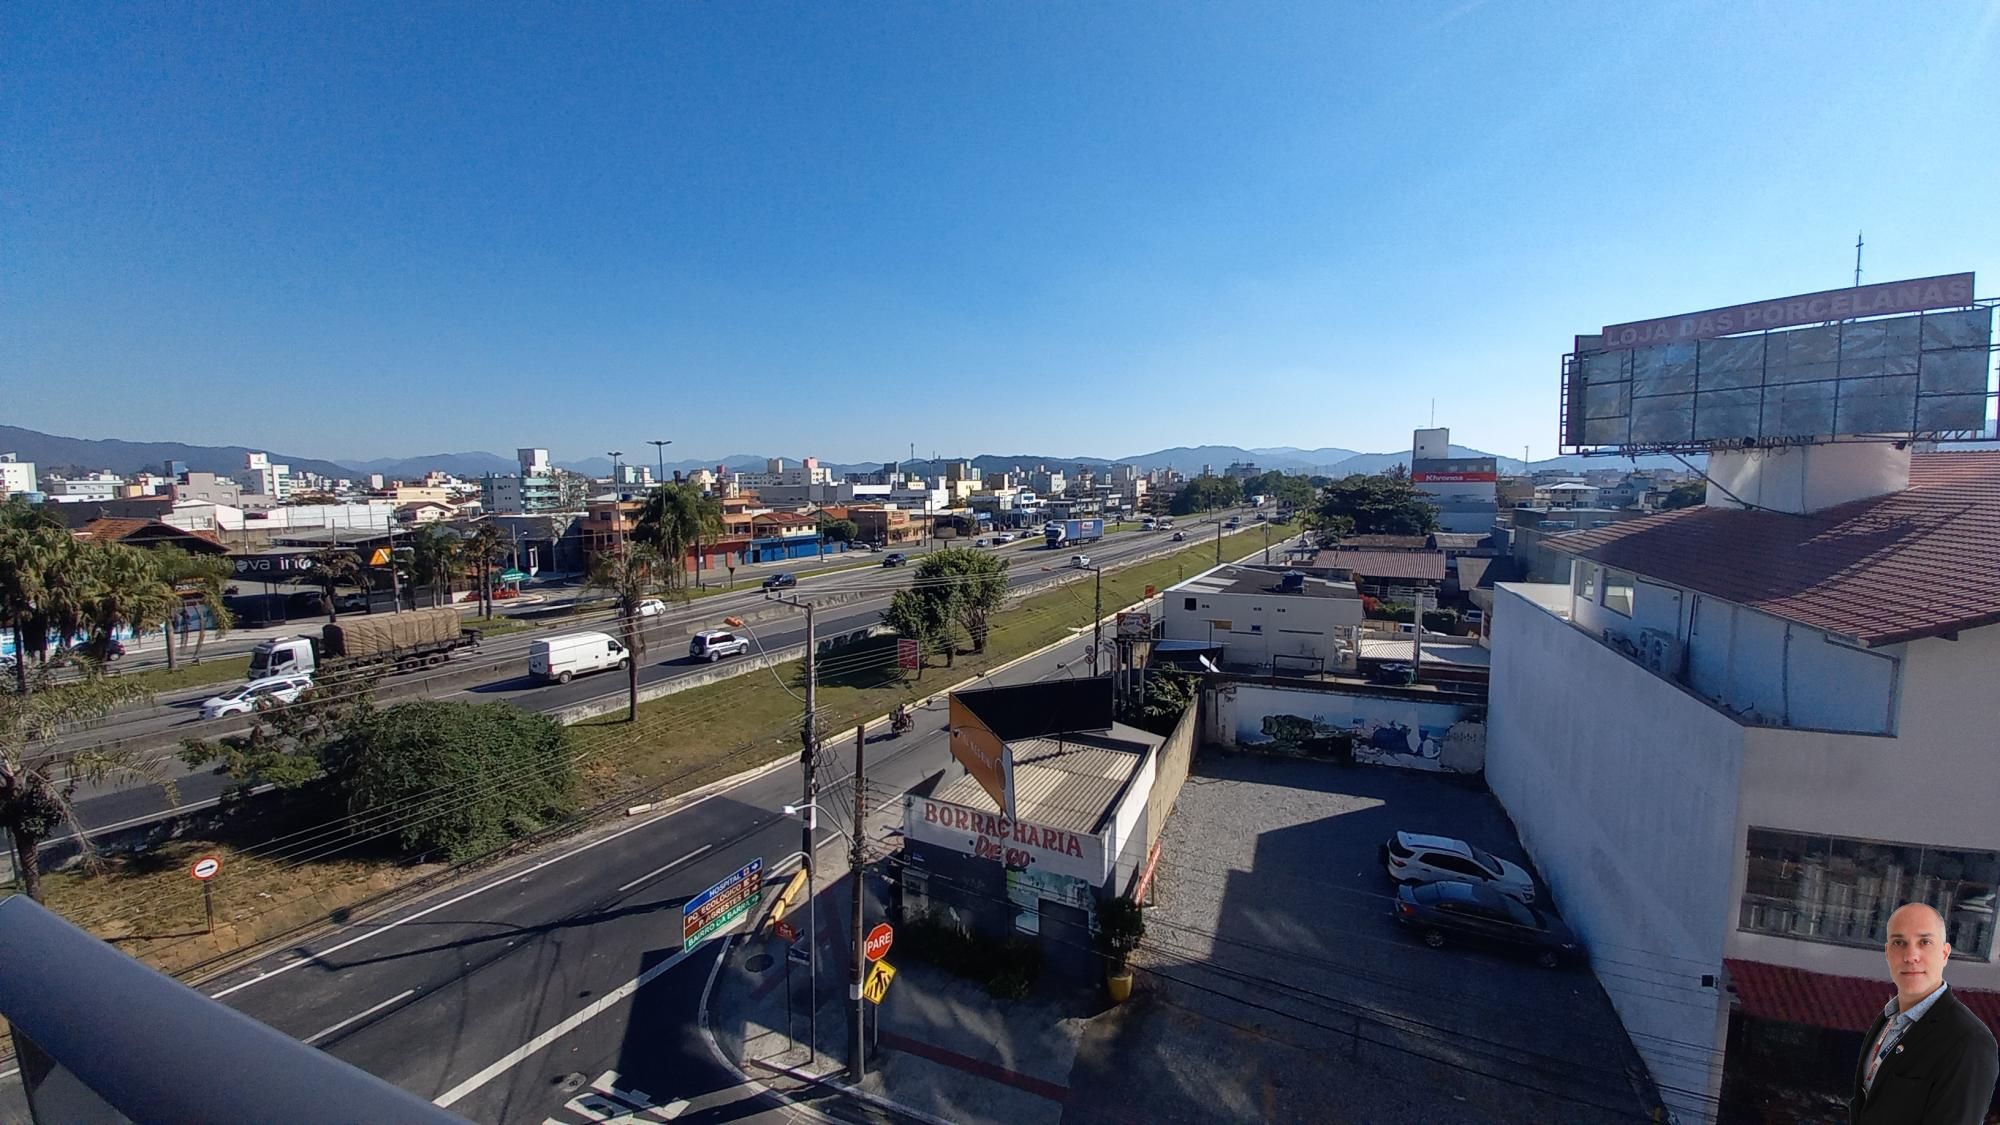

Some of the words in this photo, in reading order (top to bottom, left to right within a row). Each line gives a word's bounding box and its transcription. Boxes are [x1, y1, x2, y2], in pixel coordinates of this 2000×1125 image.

[1607, 323, 1667, 346] LOJA
[1679, 312, 1734, 337] DAS
[1744, 281, 1967, 327] PORCELANAS
[924, 802, 1083, 859] BORRACHARIA
[709, 874, 741, 897] HOSPITAL
[688, 924, 715, 946] BAIRRO
[727, 900, 751, 919] BARRA
[867, 931, 891, 954] PARE
